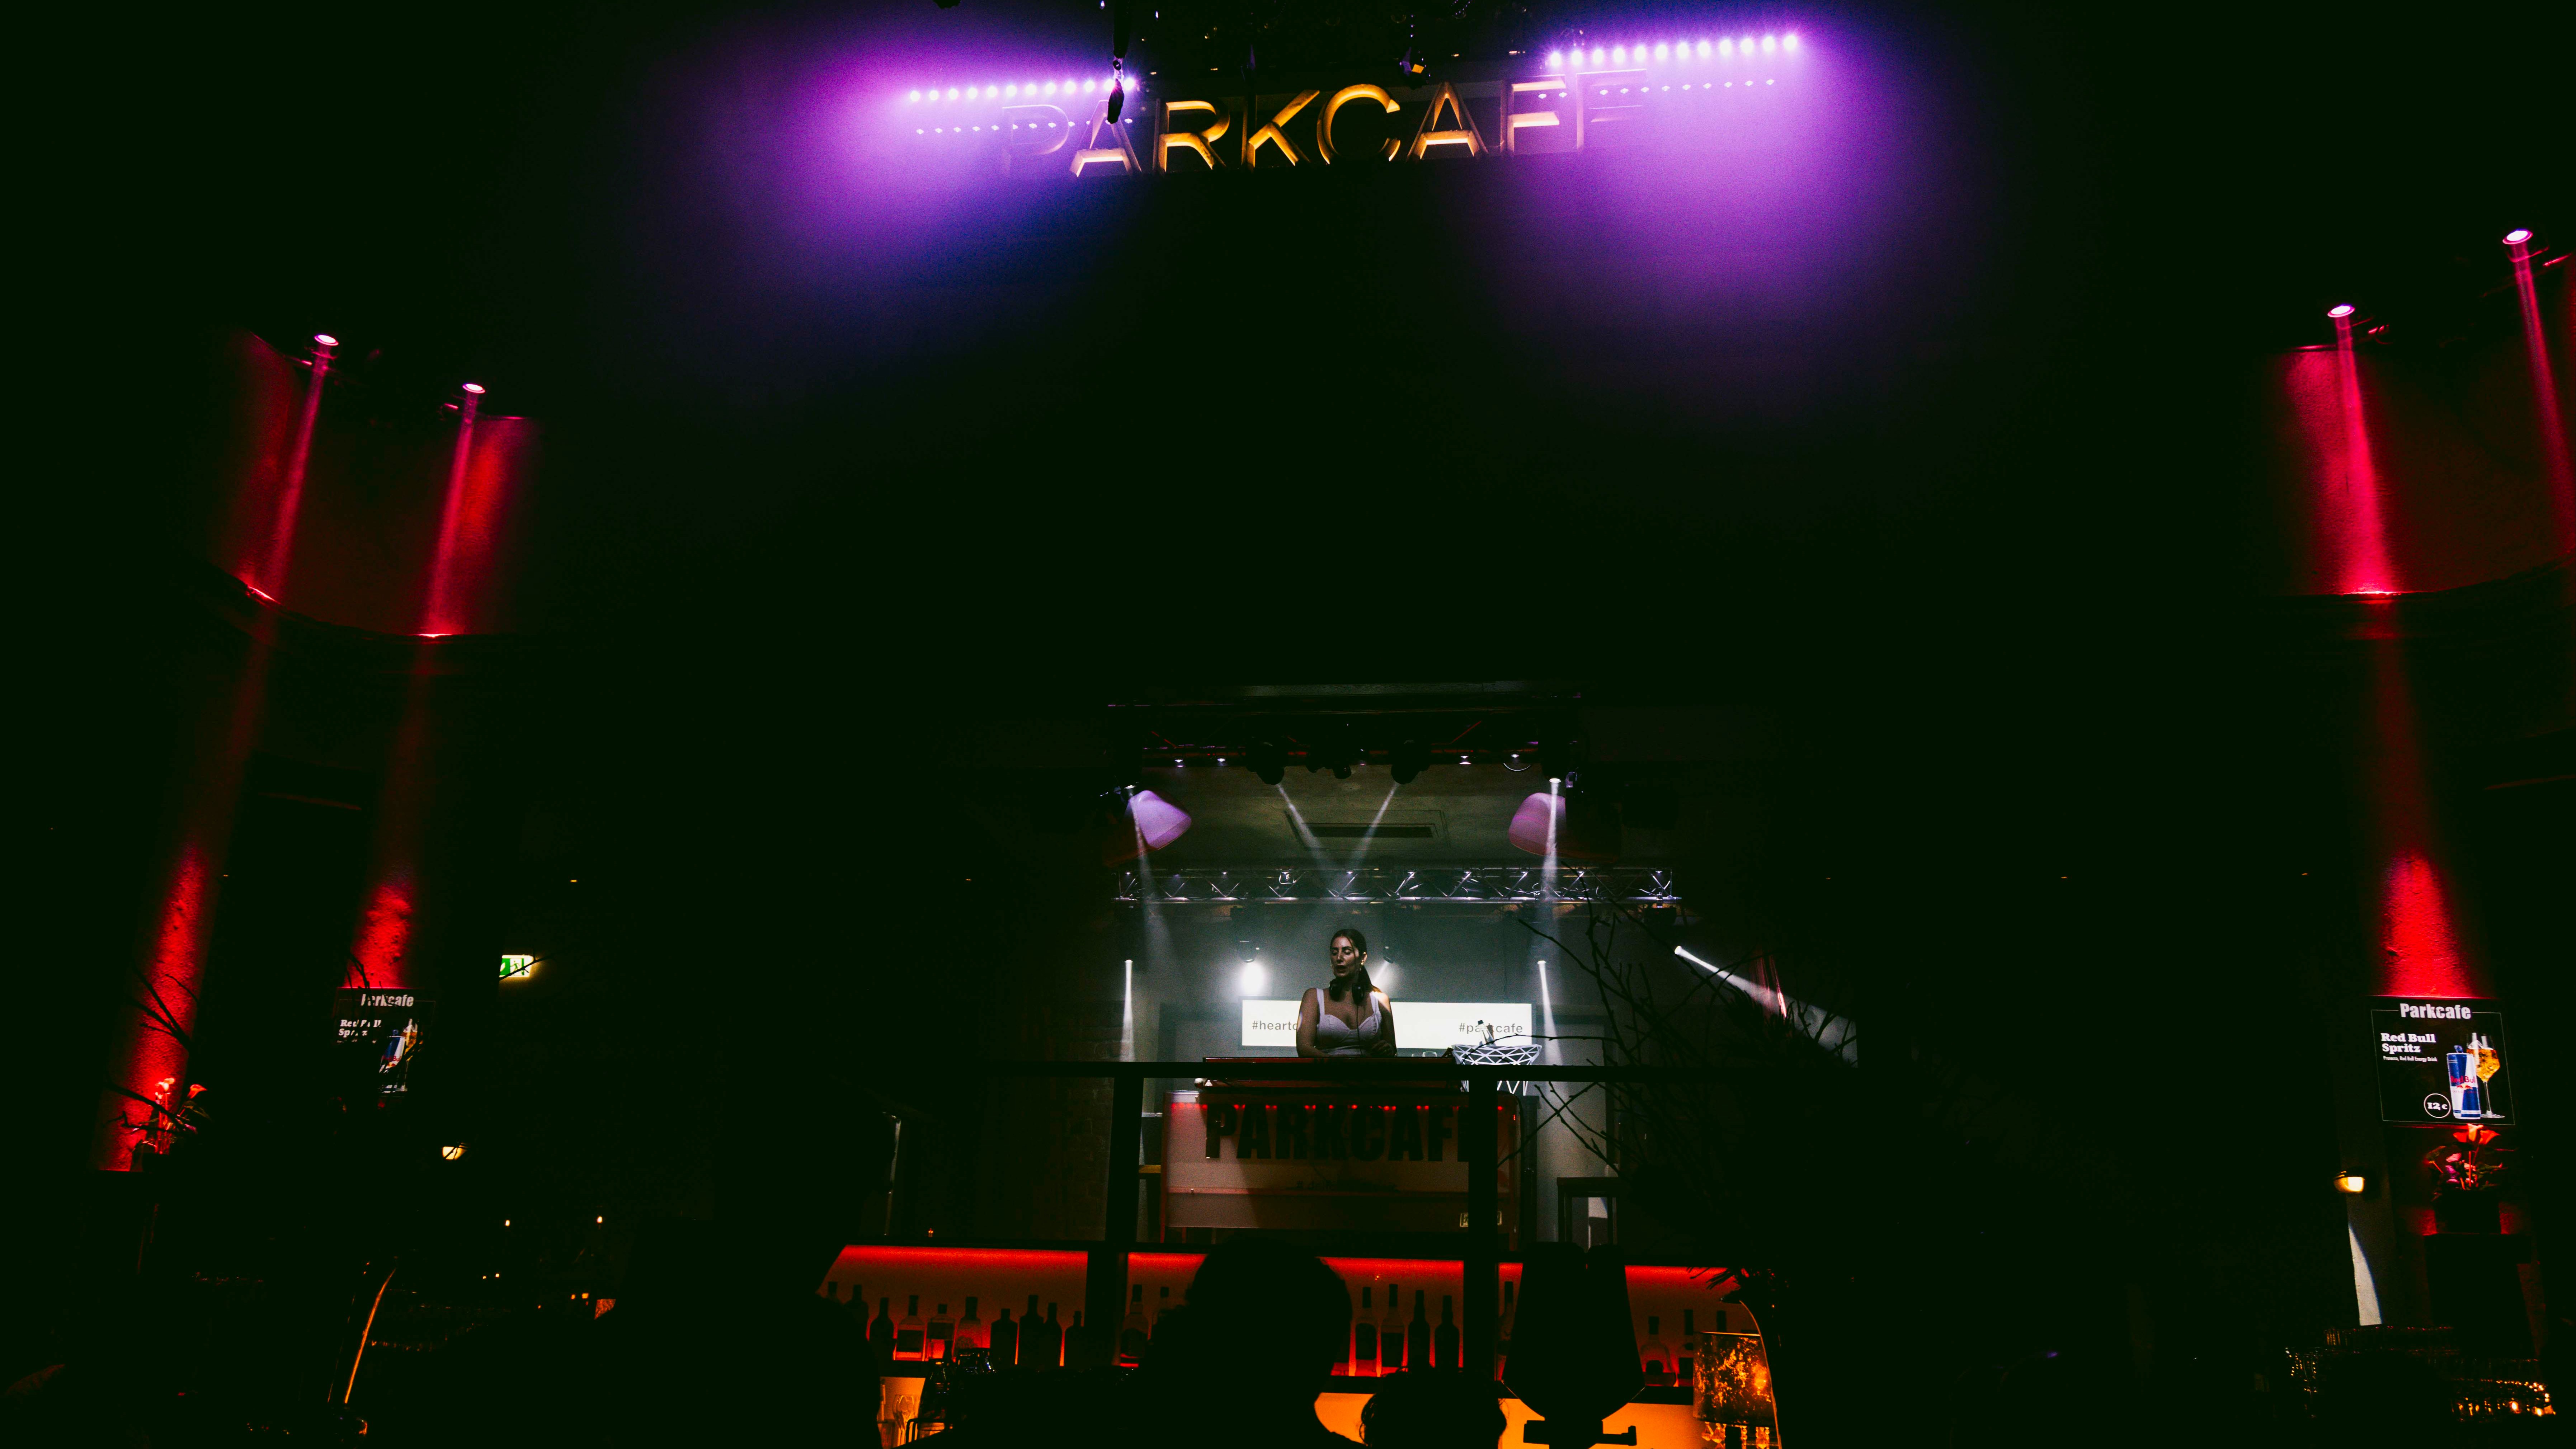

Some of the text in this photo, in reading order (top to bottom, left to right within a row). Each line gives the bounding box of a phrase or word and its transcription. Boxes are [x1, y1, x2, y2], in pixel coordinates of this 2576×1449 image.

[2400, 1003, 2472, 1019] Parkcafe
[1459, 1023, 1523, 1034] #pacafe
[2380, 1033, 2436, 1043] Red Bull
[2382, 1043, 2421, 1054] Spritz
[2427, 1102, 2441, 1111] 12
